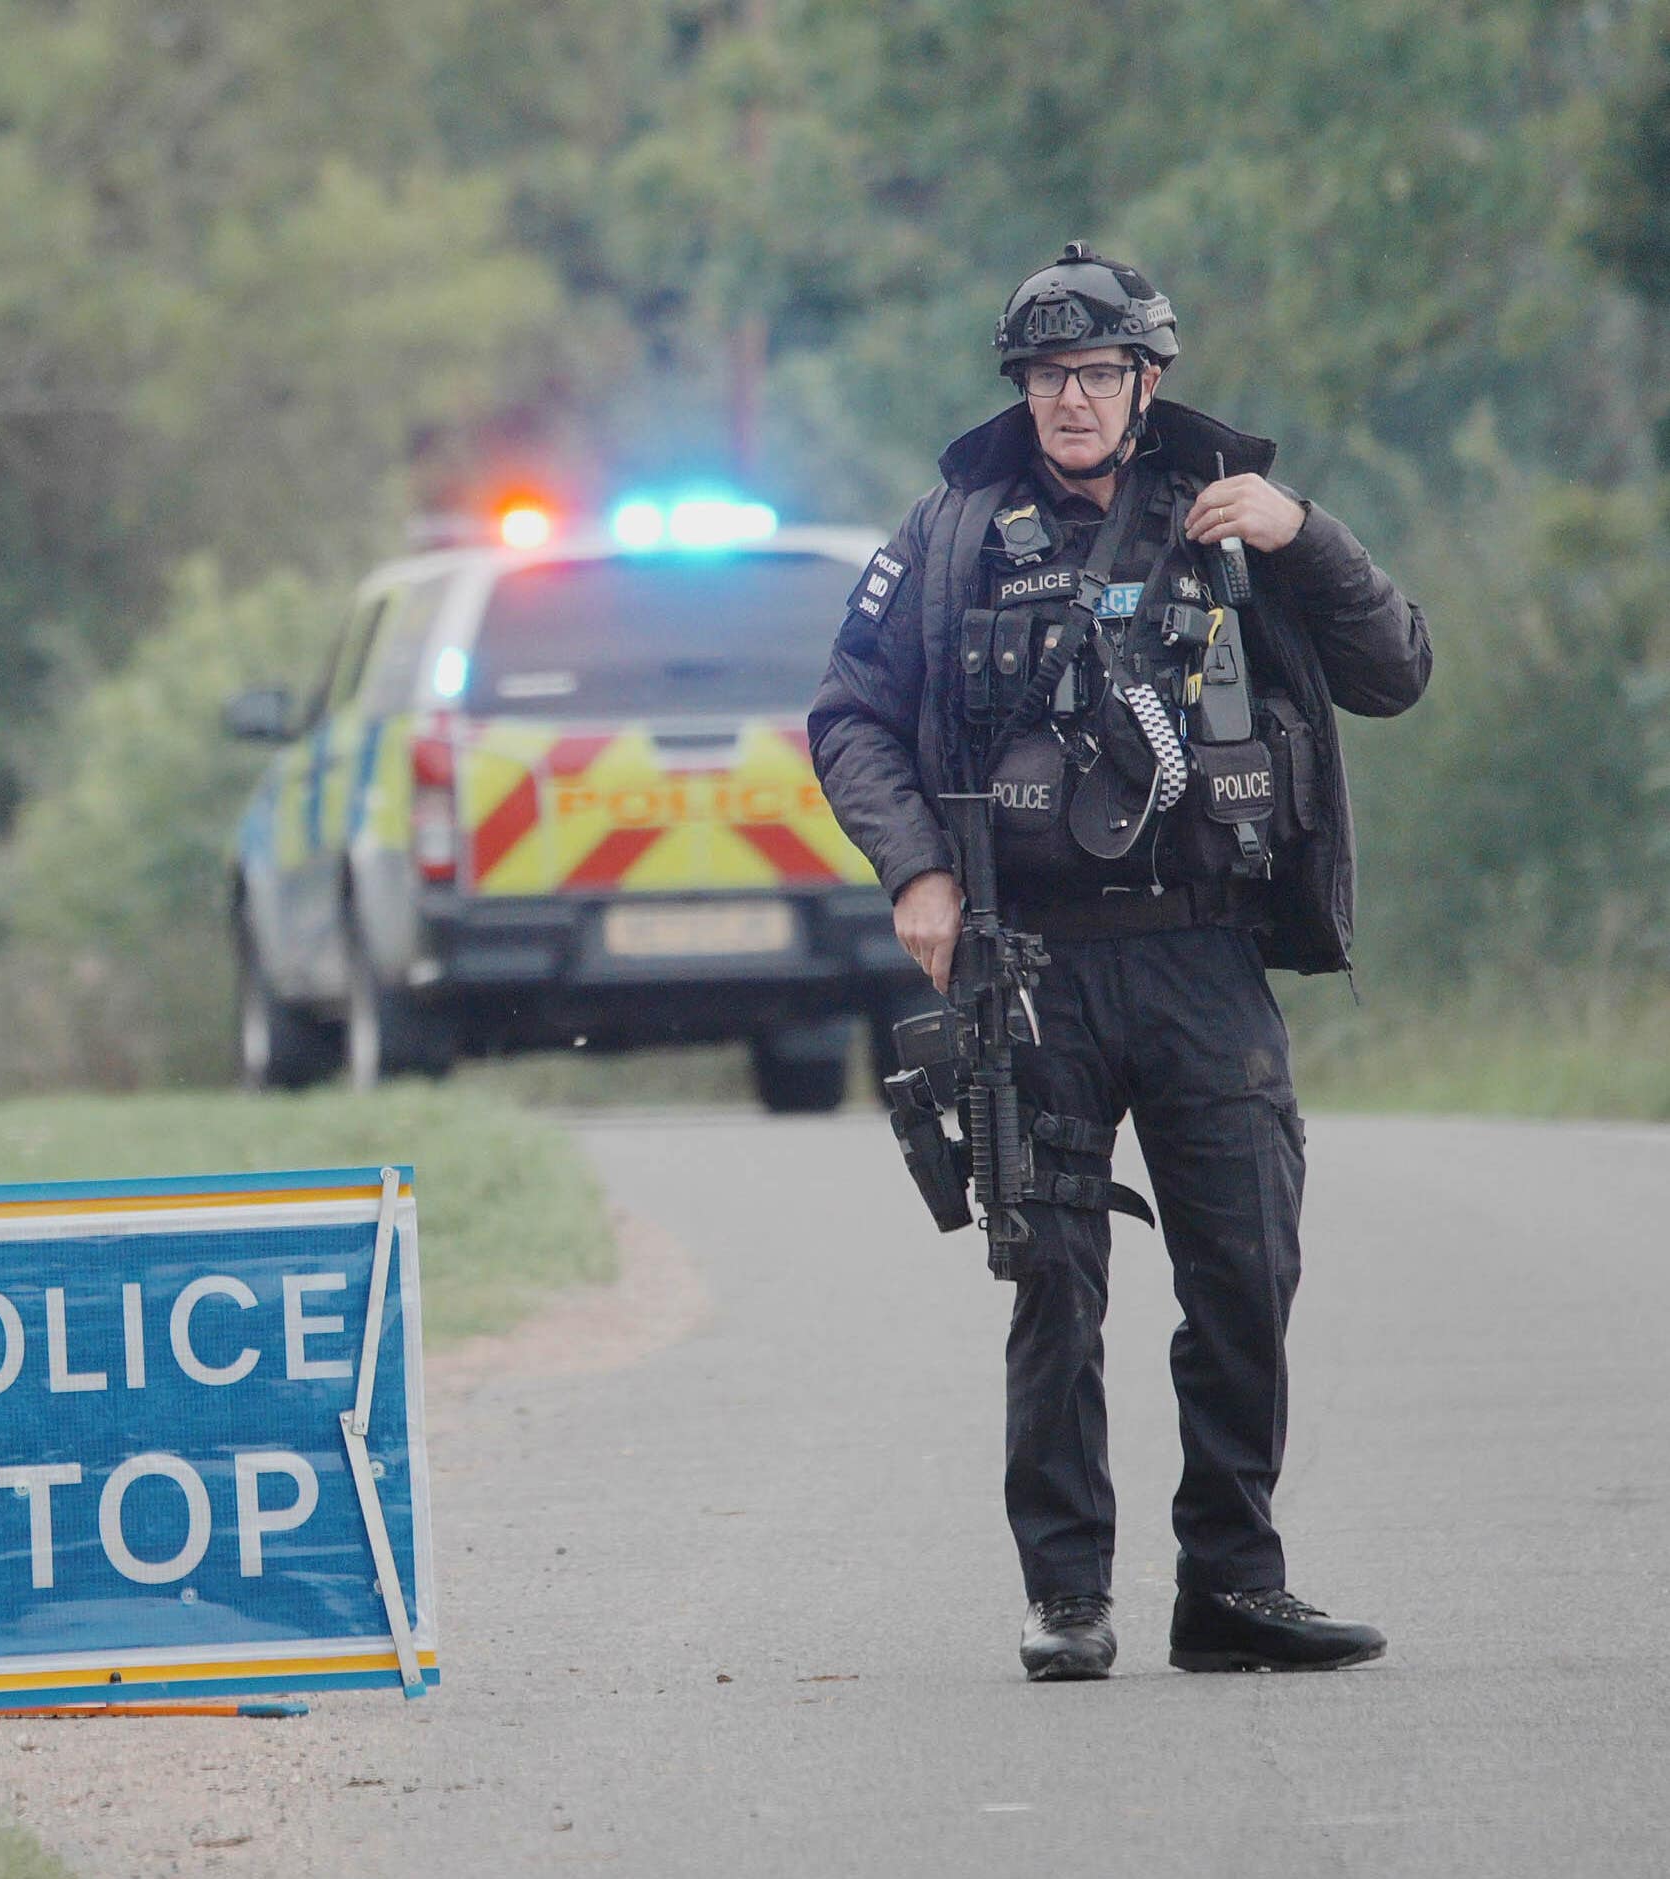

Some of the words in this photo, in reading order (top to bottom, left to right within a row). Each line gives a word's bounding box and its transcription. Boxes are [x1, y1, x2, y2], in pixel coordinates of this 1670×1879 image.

[873, 553, 904, 578] POLICE
[866, 573, 889, 597] MD
[1001, 573, 1072, 600] POLICE
[1099, 588, 1138, 614] ICE
[992, 783, 1051, 810] POLICE
[1212, 772, 1272, 801] POLICE
